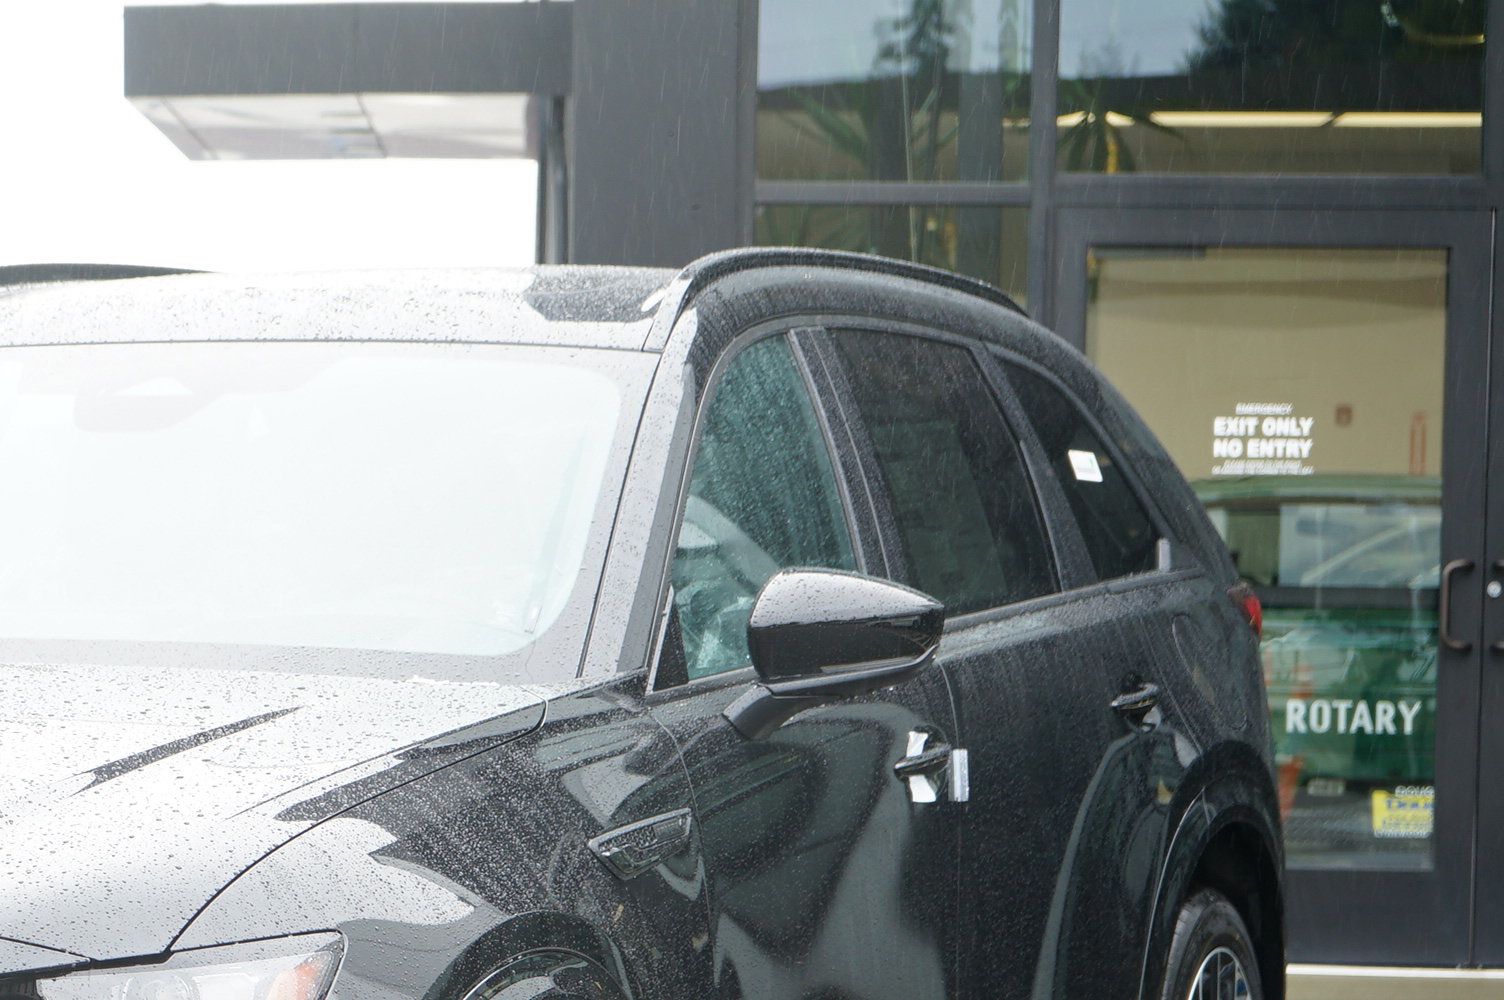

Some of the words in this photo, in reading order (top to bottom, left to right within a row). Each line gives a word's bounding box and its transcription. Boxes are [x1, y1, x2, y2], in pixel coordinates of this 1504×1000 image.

[1213, 416, 1259, 436] EXIT
[1262, 416, 1314, 437] ONLY
[1213, 438, 1244, 458] NO
[1247, 438, 1313, 458] ENTRY
[1285, 699, 1422, 735] ROTARY
